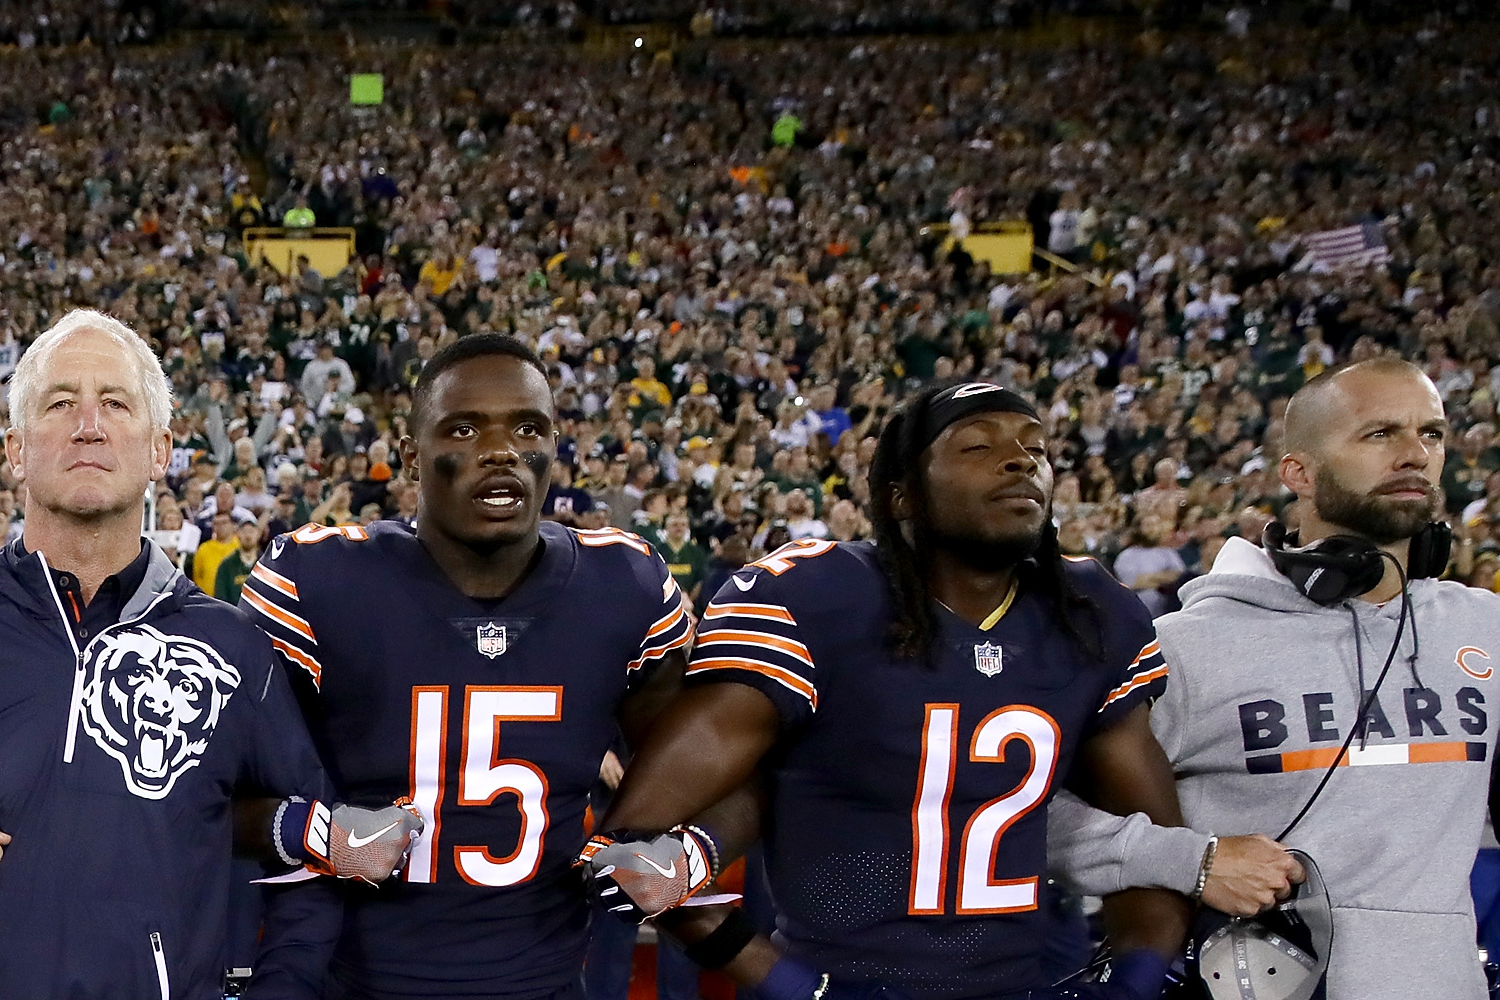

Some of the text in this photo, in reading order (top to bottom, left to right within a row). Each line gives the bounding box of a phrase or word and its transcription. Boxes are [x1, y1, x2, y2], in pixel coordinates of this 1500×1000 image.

[1238, 686, 1489, 752] BEARS
[1453, 645, 1495, 681] C
[402, 684, 564, 887] 15
[907, 702, 1063, 916] 12
